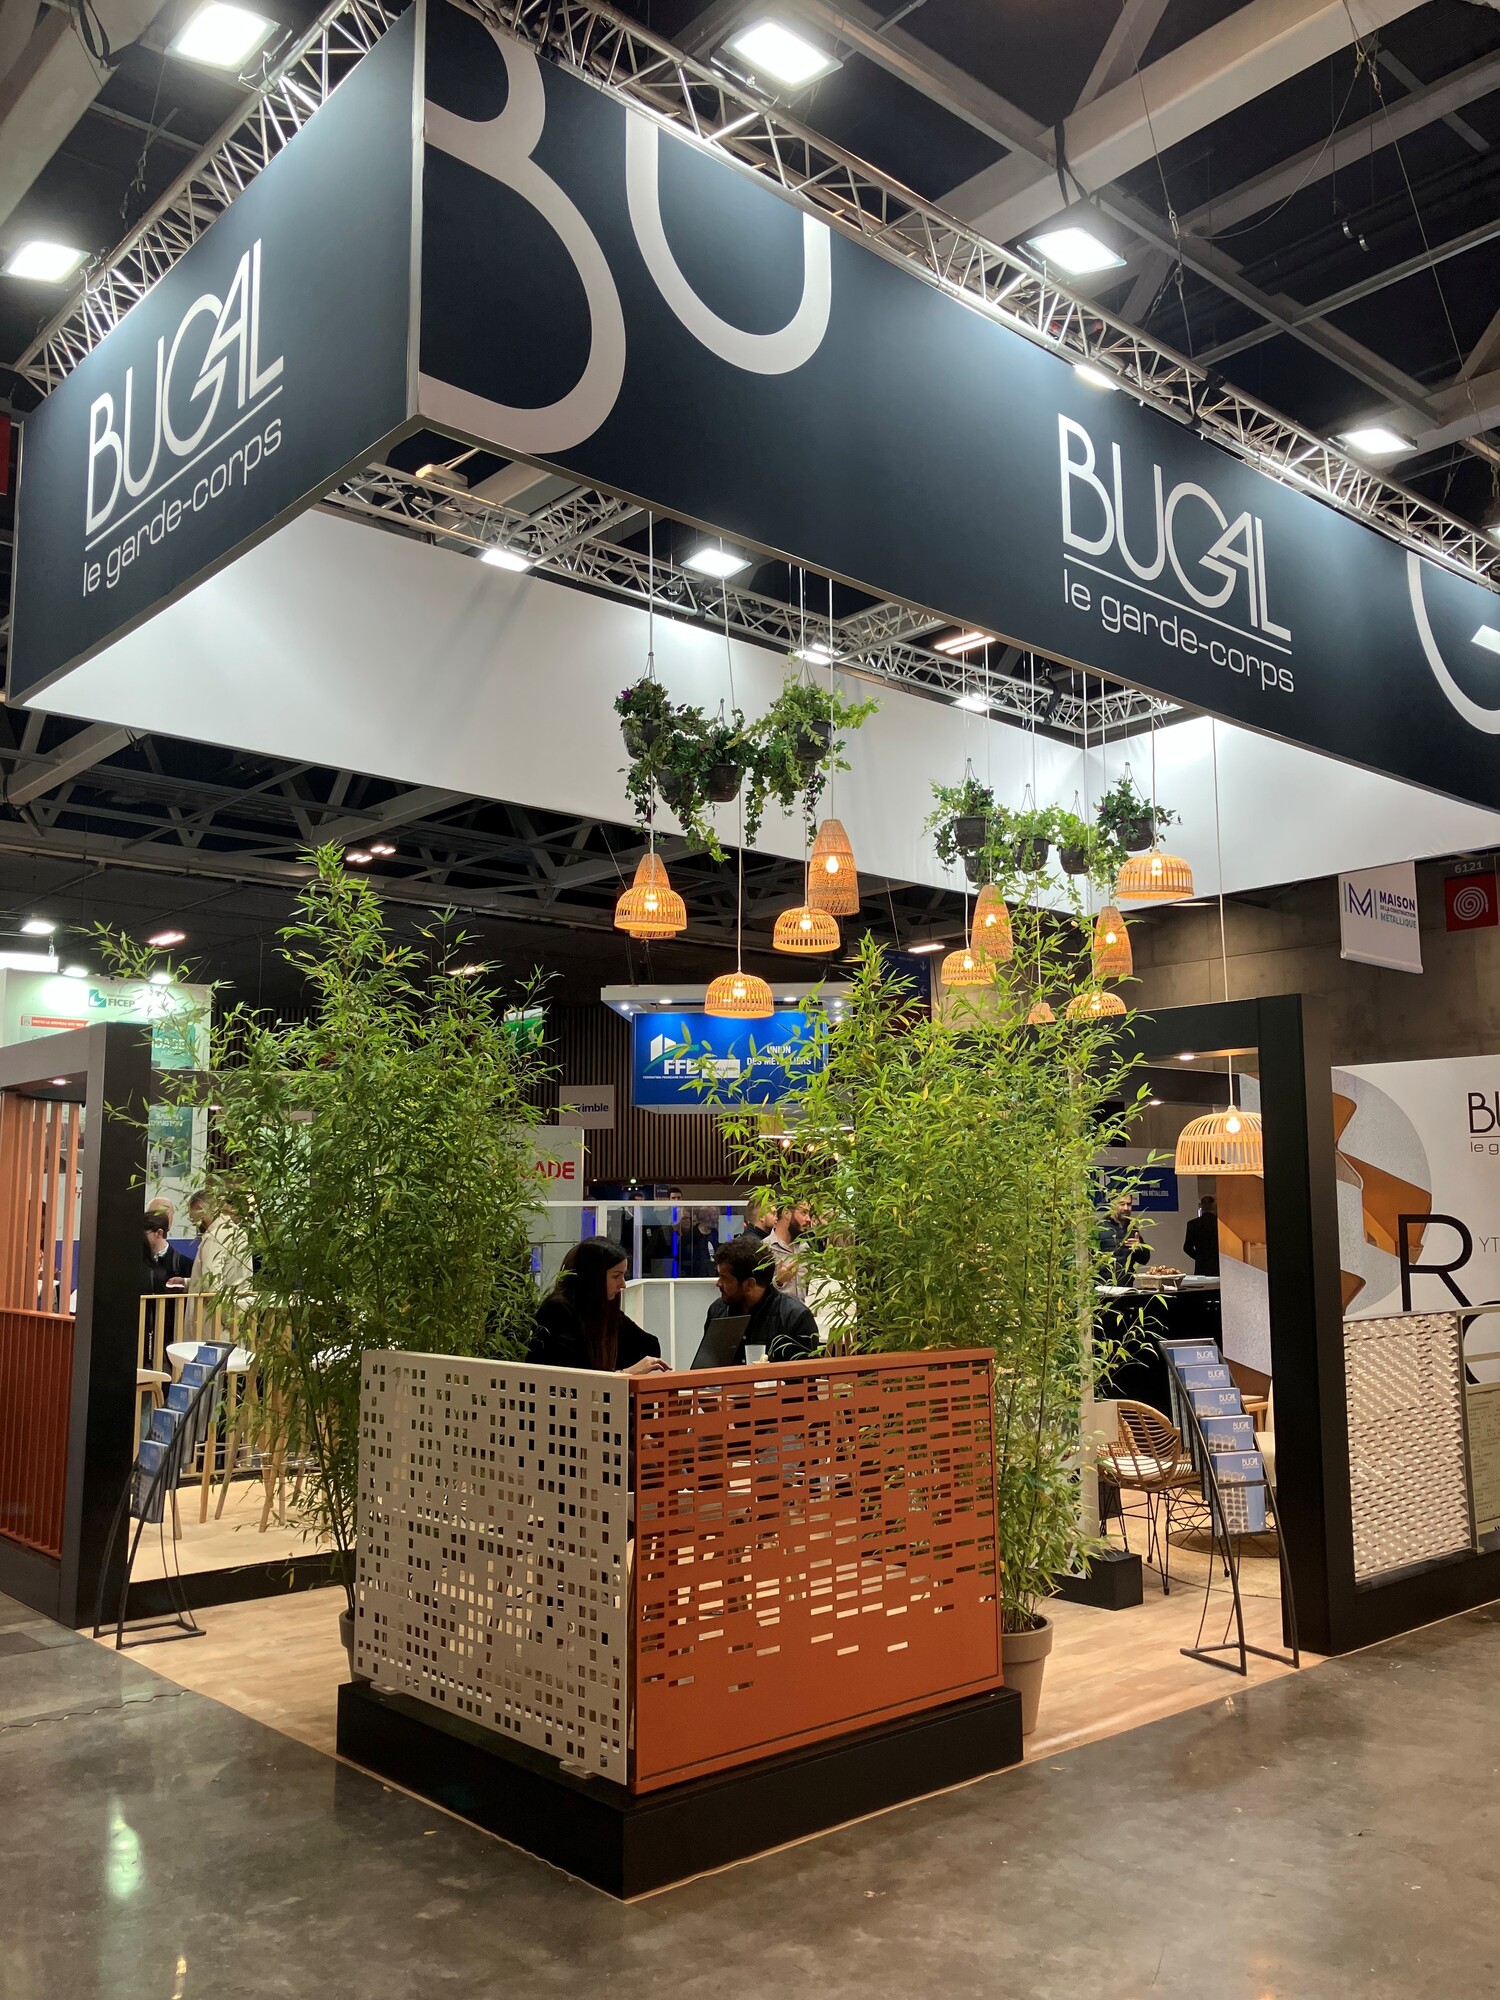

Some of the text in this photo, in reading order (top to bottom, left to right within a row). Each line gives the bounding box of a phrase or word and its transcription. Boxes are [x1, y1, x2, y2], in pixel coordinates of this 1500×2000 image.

[86, 238, 284, 536] BUGAL
[83, 415, 284, 598] le garde-corps
[1058, 412, 1292, 641] BUGAL
[1063, 568, 1295, 694] le garde-corps
[1454, 861, 1484, 874] 6121
[1379, 890, 1416, 912] MAISON
[1380, 912, 1417, 929] MÉTALLIQUE
[108, 998, 135, 1007] FICEP
[767, 1045, 791, 1054] UNION
[1470, 1141, 1484, 1153] le
